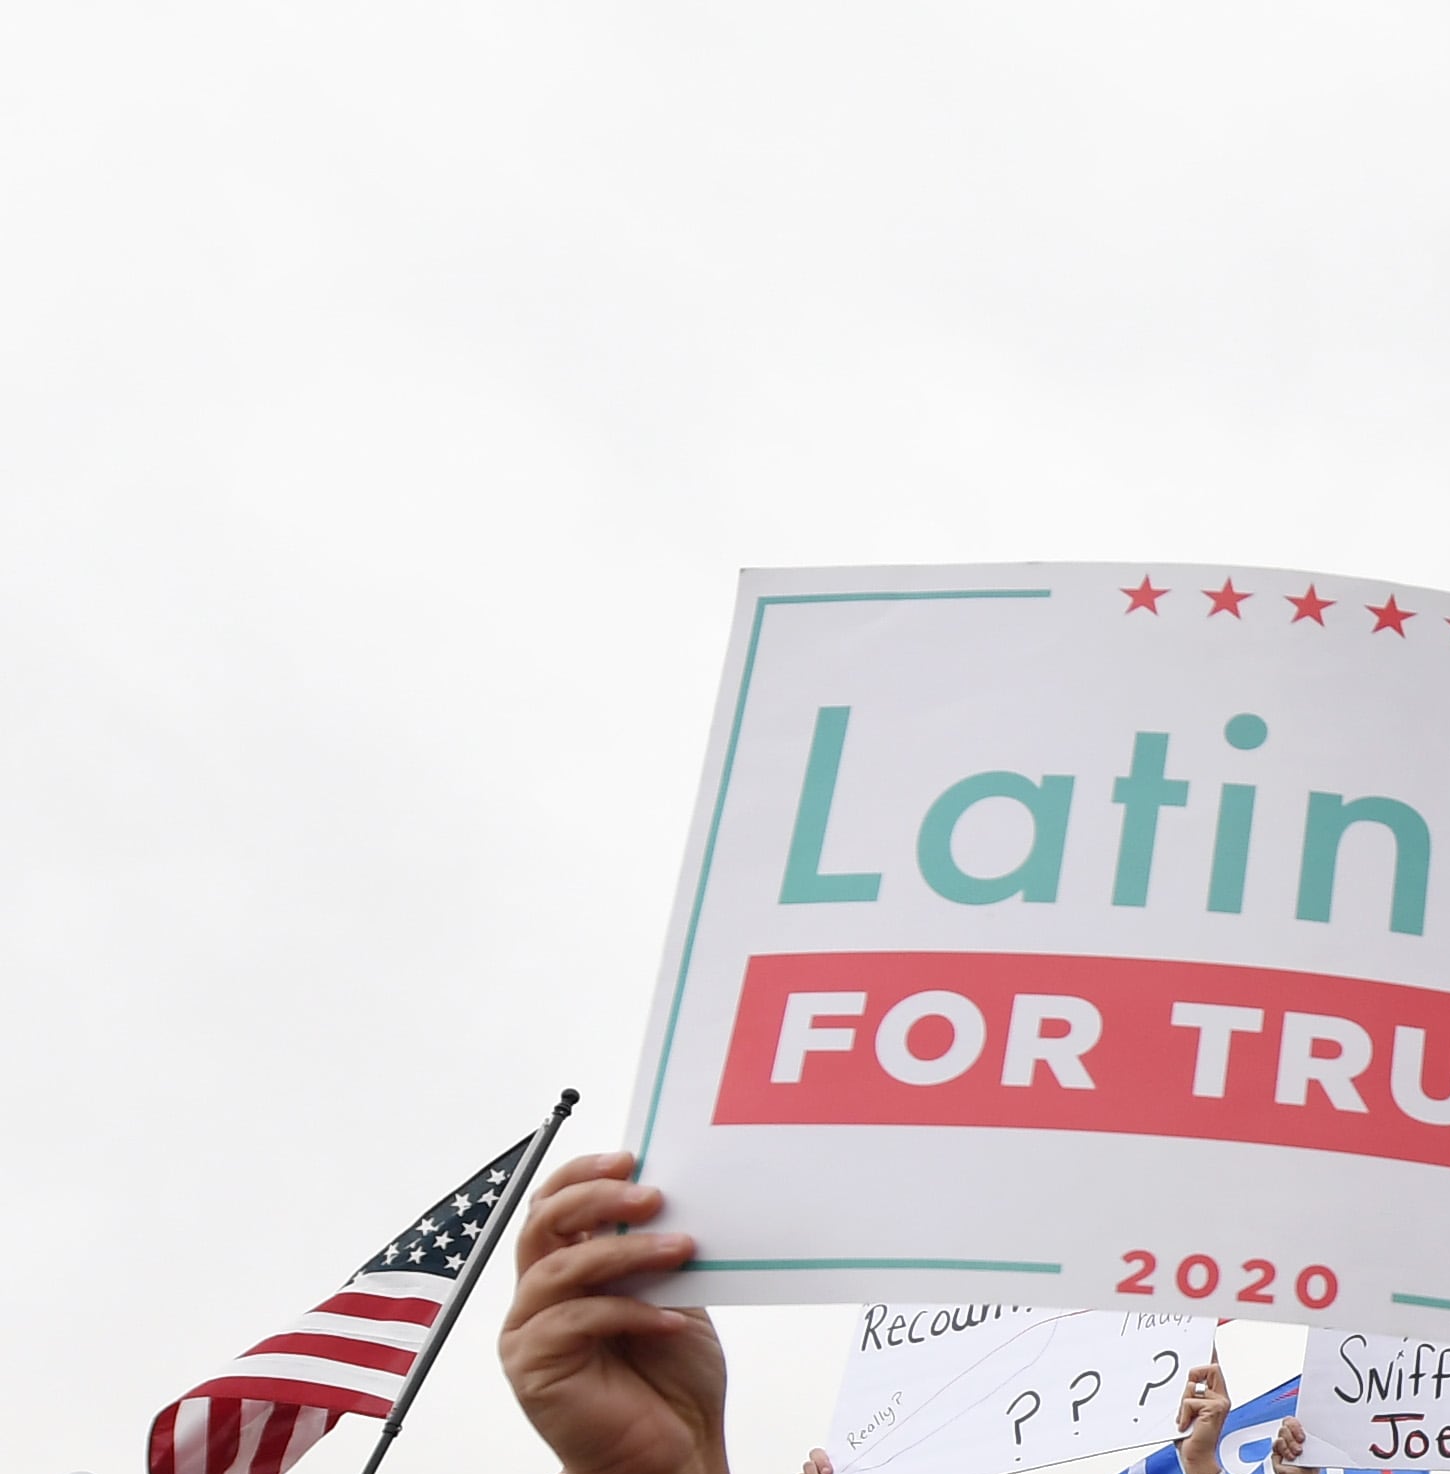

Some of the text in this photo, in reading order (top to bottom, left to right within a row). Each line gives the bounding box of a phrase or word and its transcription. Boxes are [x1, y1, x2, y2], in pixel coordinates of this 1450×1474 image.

[767, 989, 1104, 1089] FOR
[1114, 1249, 1340, 1310] 2020
[847, 1391, 904, 1452] Really?
